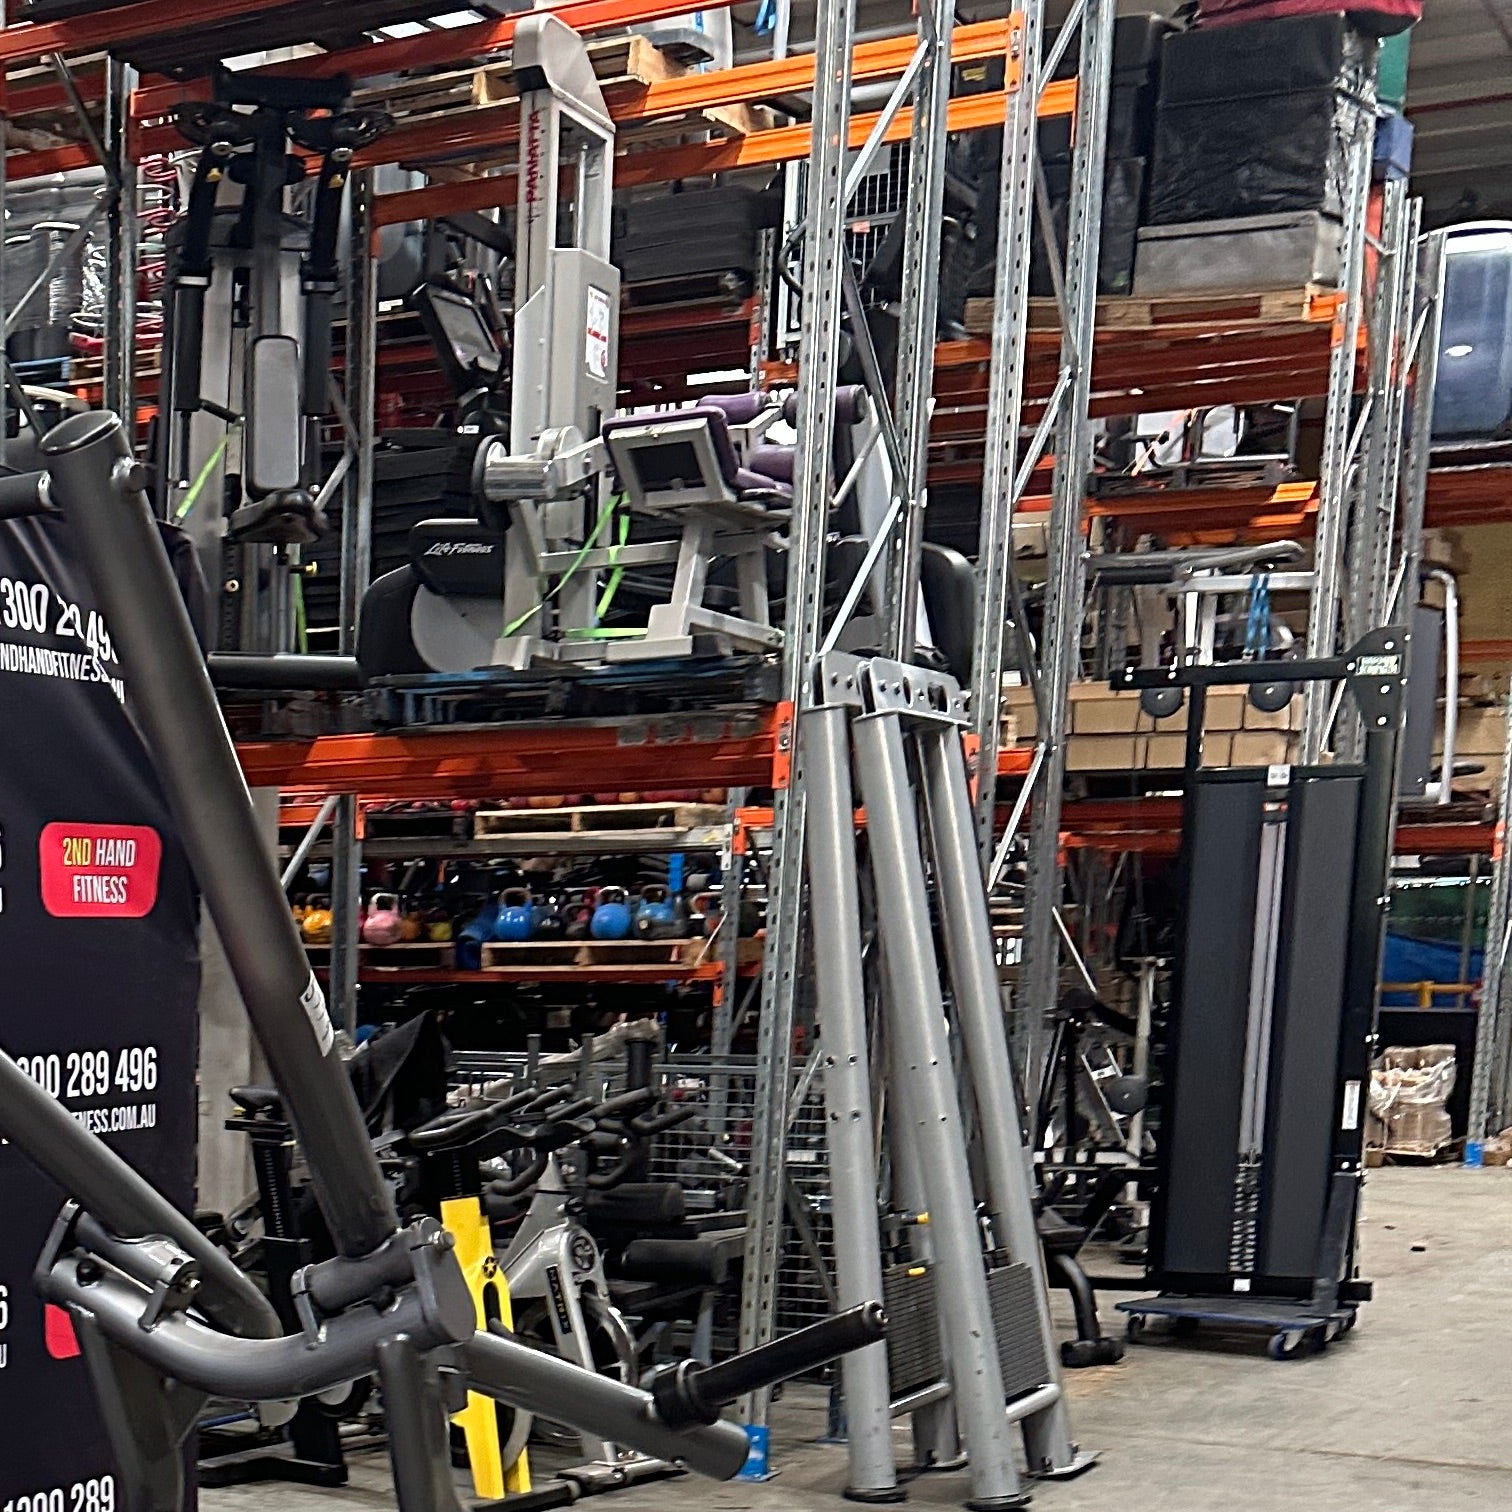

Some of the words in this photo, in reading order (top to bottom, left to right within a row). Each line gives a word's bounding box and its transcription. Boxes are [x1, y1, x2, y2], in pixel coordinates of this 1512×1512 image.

[86, 610, 119, 665] 49
[62, 837, 92, 867] 2ND
[94, 838, 136, 868] HAND
[72, 874, 128, 904] FITNESS
[66, 1050, 110, 1098] 289
[114, 1046, 157, 1093] 496
